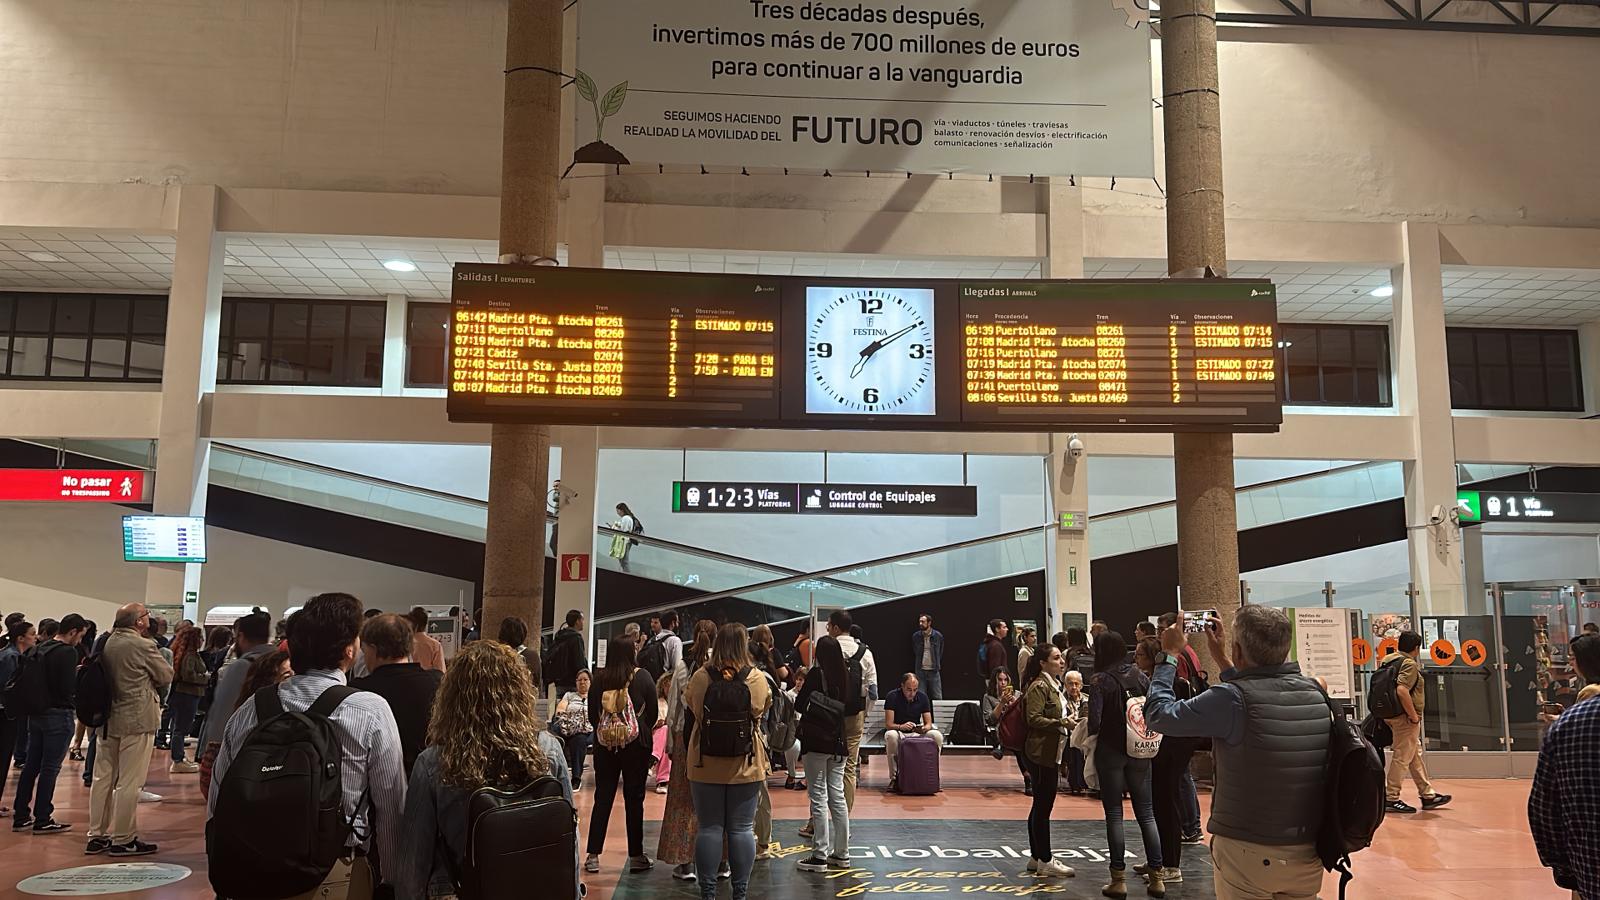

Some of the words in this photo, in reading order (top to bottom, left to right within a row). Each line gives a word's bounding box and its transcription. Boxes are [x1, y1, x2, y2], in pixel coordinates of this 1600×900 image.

[750, 0, 794, 19] Tres
[800, 2, 887, 23] décadas
[893, 5, 985, 29] después,
[653, 24, 765, 47] invertimos
[771, 30, 814, 48] más
[821, 31, 845, 50] de
[851, 33, 892, 52] 700
[901, 35, 985, 54] millones
[992, 37, 1016, 56] de
[1022, 42, 1079, 57] euros
[712, 60, 757, 79] para
[764, 60, 863, 80] continuar
[869, 65, 880, 80] a
[887, 62, 903, 81] la
[909, 66, 1023, 88] vanguardia
[664, 110, 723, 123] SEGUIMOS
[725, 112, 781, 125] HACIENDO
[952, 119, 990, 127] viaductos
[996, 120, 1026, 128] túneles
[1032, 121, 1069, 129] traviesas
[624, 125, 679, 137] REALIDAD
[682, 127, 696, 138] LA
[699, 128, 759, 140] MOVILIDAD
[761, 130, 782, 141] DEL
[792, 116, 923, 145] FUTURO
[934, 128, 963, 136] balasto
[969, 130, 1014, 138] renovación
[1052, 132, 1108, 140] electrificación
[934, 140, 998, 148] comunicaciones
[1004, 140, 1053, 149] señalización
[457, 272, 492, 282] Salidas
[500, 276, 536, 284] DEPARTURES
[964, 288, 1005, 298] Llegadas
[858, 299, 883, 314] 12
[456, 312, 487, 322] 06:42
[488, 312, 524, 324] Madrid
[529, 314, 552, 325] Pta.
[558, 316, 593, 326] Atocha
[670, 319, 678, 330] 2
[695, 320, 741, 331] ESTIMADO
[745, 322, 774, 332] 07:15
[456, 324, 486, 334] 07:11
[488, 325, 553, 336] Puertollano
[670, 330, 676, 340] 1
[966, 326, 994, 336] 06:39
[996, 326, 1056, 336] Puertollano
[1170, 326, 1177, 336] 2
[1194, 326, 1239, 336] ESTIMADO
[1243, 326, 1272, 336] 07:14
[455, 336, 486, 346] 07:19
[488, 336, 524, 348] Madrid
[528, 338, 551, 348] Pta.
[557, 339, 592, 349] Atocha
[670, 342, 678, 352] 2
[996, 337, 1030, 347] Madrid
[1034, 338, 1056, 347] Pta.
[1062, 337, 1095, 347] Atocha
[1170, 338, 1177, 347] 1
[1195, 338, 1240, 347] ESTIMADO
[1244, 338, 1273, 347] 07:15
[454, 347, 485, 357] 07:21
[488, 348, 518, 358] Cádiz
[670, 353, 676, 363] 1
[732, 355, 757, 365] PARA
[760, 356, 774, 366] EN
[816, 342, 832, 358] 9
[909, 344, 925, 360] 3
[966, 348, 995, 358] 07:16
[996, 348, 1058, 358] Puertollano
[1170, 348, 1178, 358] 2
[486, 360, 528, 370] Sevilla
[533, 362, 556, 372] Sta.
[562, 363, 592, 372] Justa
[669, 364, 676, 374] 1
[732, 366, 756, 376] PARA
[760, 367, 774, 377] EN
[966, 360, 995, 368] 07:19
[997, 360, 1030, 368] Madrid
[1034, 360, 1056, 369] Pta.
[1062, 360, 1096, 369] Atocha
[1171, 360, 1178, 369] 1
[1196, 360, 1242, 369] ESTIMADO
[1246, 360, 1274, 370] 07:27
[454, 370, 484, 380] 07:44
[486, 372, 523, 382] Madrid
[527, 373, 550, 382] Pta.
[556, 374, 592, 384] Atocha
[668, 376, 676, 386] 2
[966, 370, 995, 380] 07:39
[997, 370, 1030, 380] Madrid
[1035, 371, 1057, 380] Pta.
[1062, 370, 1096, 380] Atocha
[1172, 371, 1178, 380] 1
[1196, 371, 1242, 380] ESTIMADO
[1246, 372, 1274, 380] 07:49
[486, 384, 522, 393] Madrid
[526, 384, 548, 394] Pta.
[556, 385, 591, 395] Atocha
[668, 387, 676, 398] 2
[967, 382, 996, 391] 07:41
[997, 382, 1059, 391] Puertollano
[1173, 382, 1180, 392] 2
[863, 388, 879, 404] 6
[997, 393, 1037, 402] Sevilla
[1042, 394, 1063, 402] Sta.
[1069, 394, 1098, 403] Justa
[1173, 394, 1180, 403] 2
[62, 476, 78, 486] No
[80, 478, 112, 488] pasar
[757, 488, 779, 500] Vías
[828, 490, 866, 501] Control
[870, 491, 882, 501] de
[886, 491, 936, 504] Equipajes
[1506, 496, 1520, 516] 1
[1523, 497, 1541, 509] Vía
[824, 868, 875, 878] Te
[886, 868, 1005, 878] desea
[836, 881, 950, 897] feliz
[962, 884, 1066, 896] viaje
